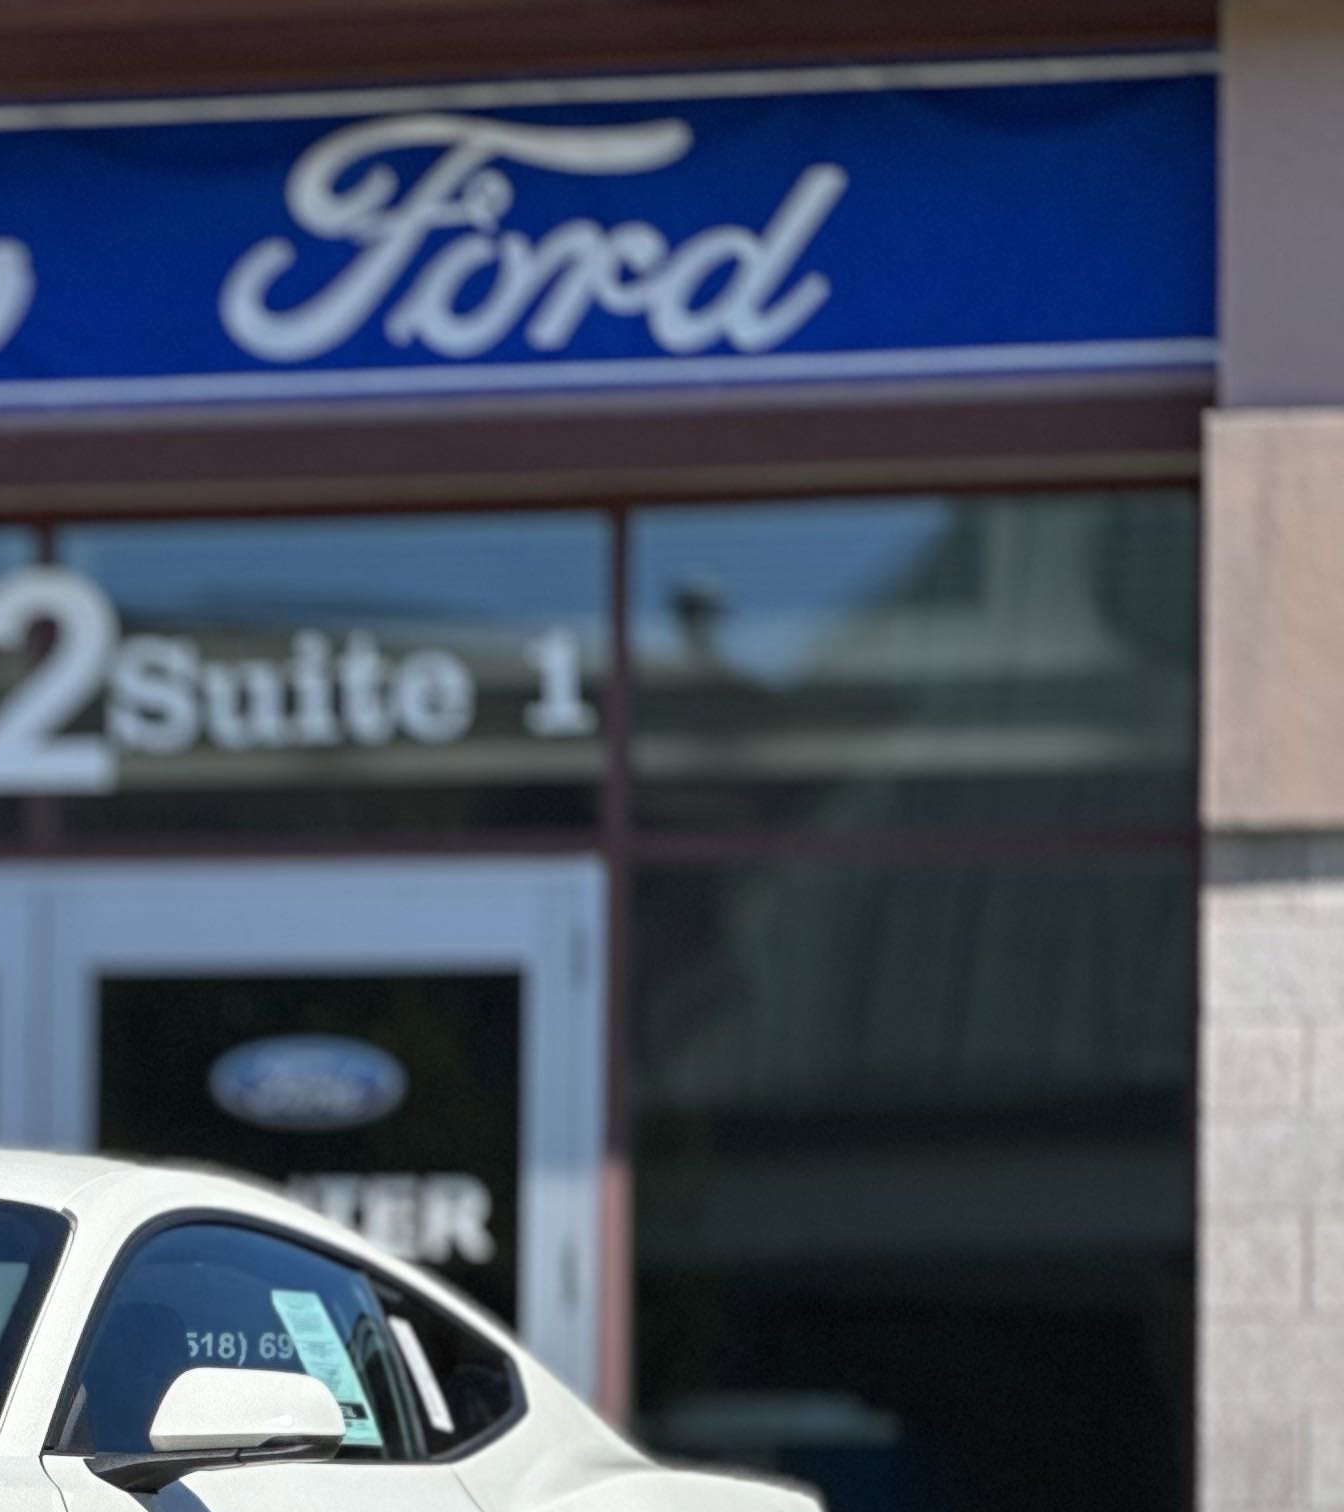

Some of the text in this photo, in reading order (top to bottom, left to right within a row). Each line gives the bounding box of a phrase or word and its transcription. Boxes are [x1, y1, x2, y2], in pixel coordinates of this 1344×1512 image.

[217, 112, 850, 364] Ford
[108, 628, 476, 754] Suite
[524, 628, 600, 737] 1
[290, 1171, 496, 1264] TER
